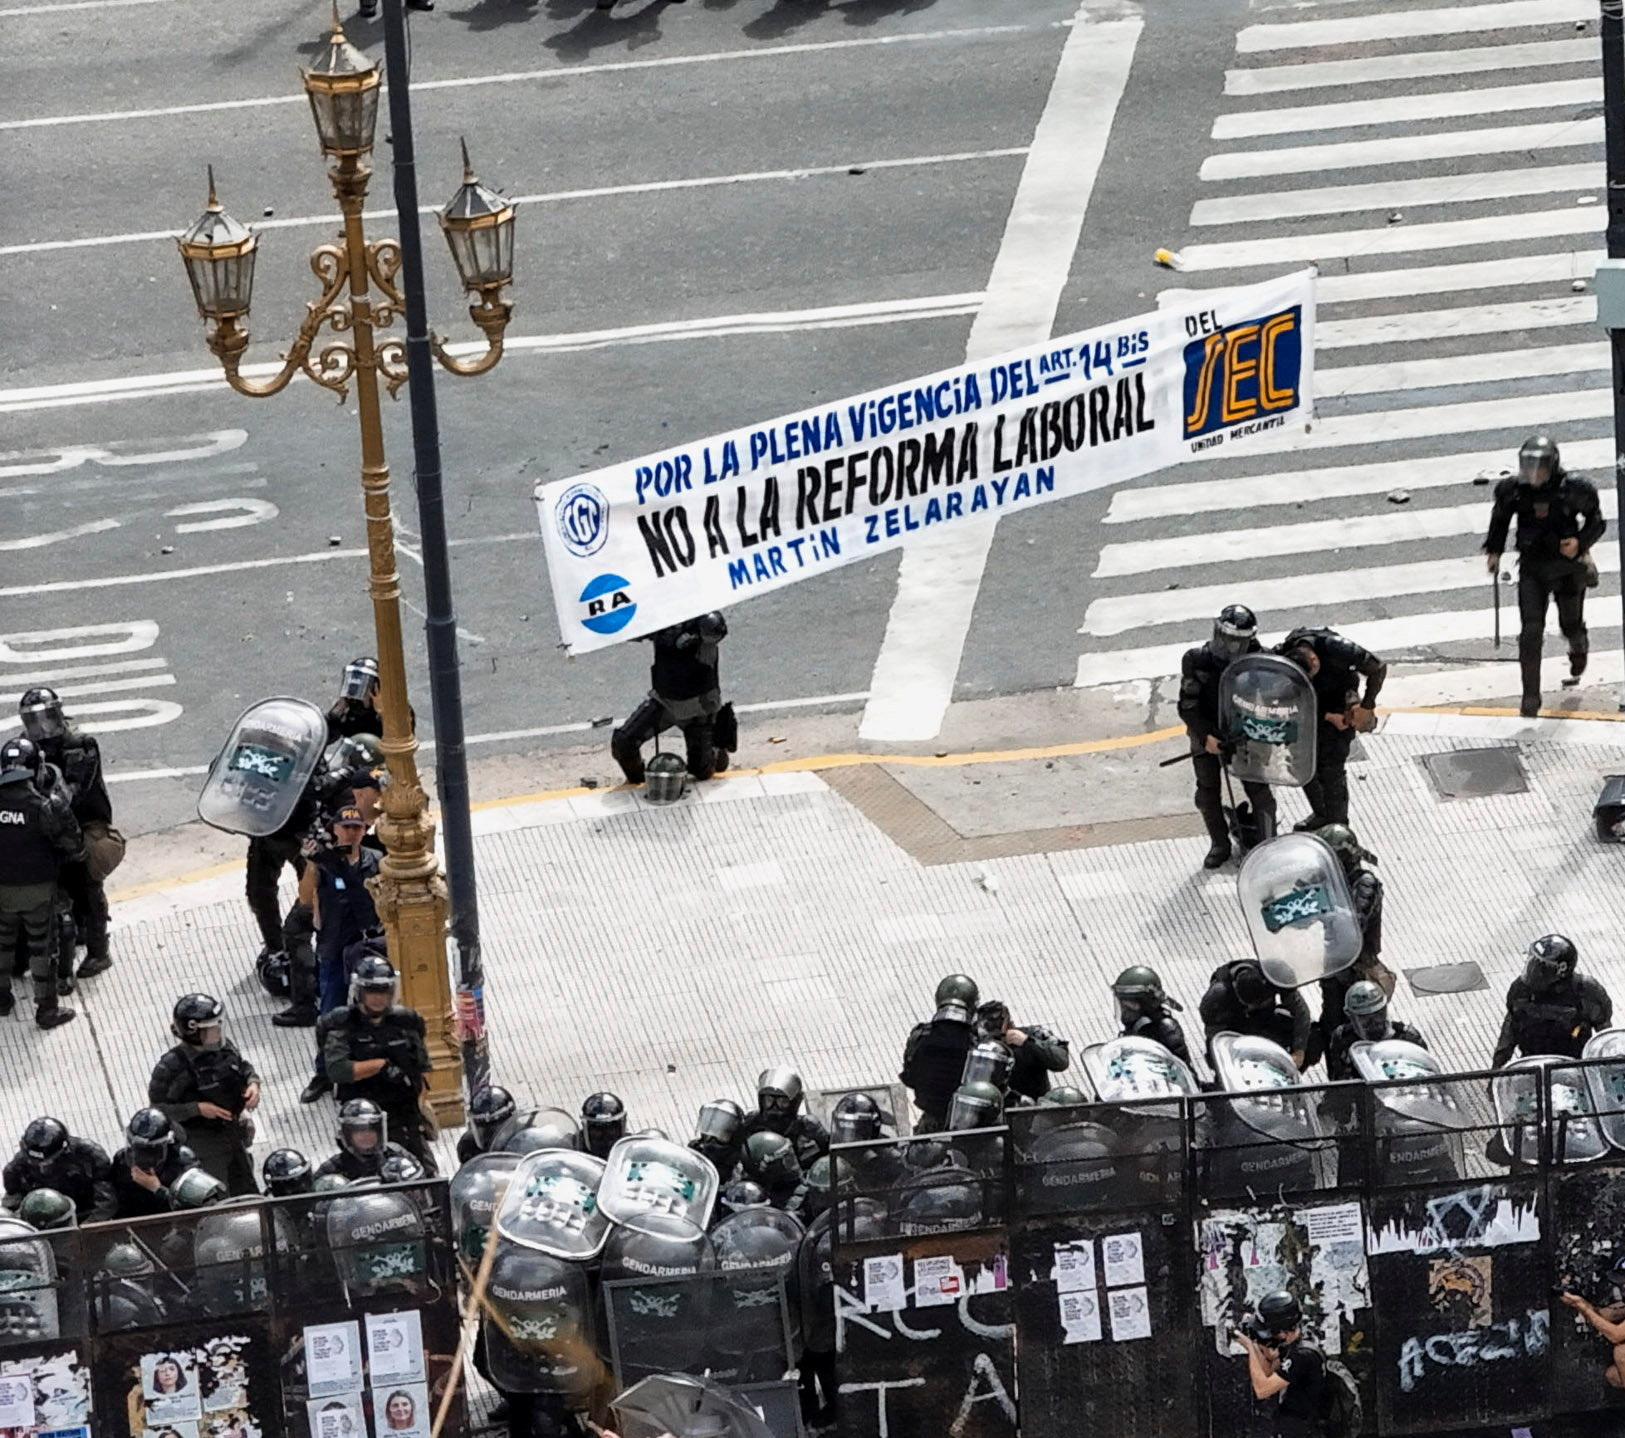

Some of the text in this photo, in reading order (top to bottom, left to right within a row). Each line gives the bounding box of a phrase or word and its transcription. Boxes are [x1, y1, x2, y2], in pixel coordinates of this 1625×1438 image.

[634, 454, 694, 505] POR
[702, 441, 741, 484] LA
[749, 411, 845, 472] PLENA
[990, 357, 1039, 406] DEL
[1078, 343, 1114, 381] 14
[635, 370, 1156, 579] NO A LA REFORMA LABORAL
[864, 465, 1056, 544] ZELARAYAN
[491, 1283, 568, 1301] GENDARMERIA
[621, 1256, 698, 1277] GENDARMERIA
